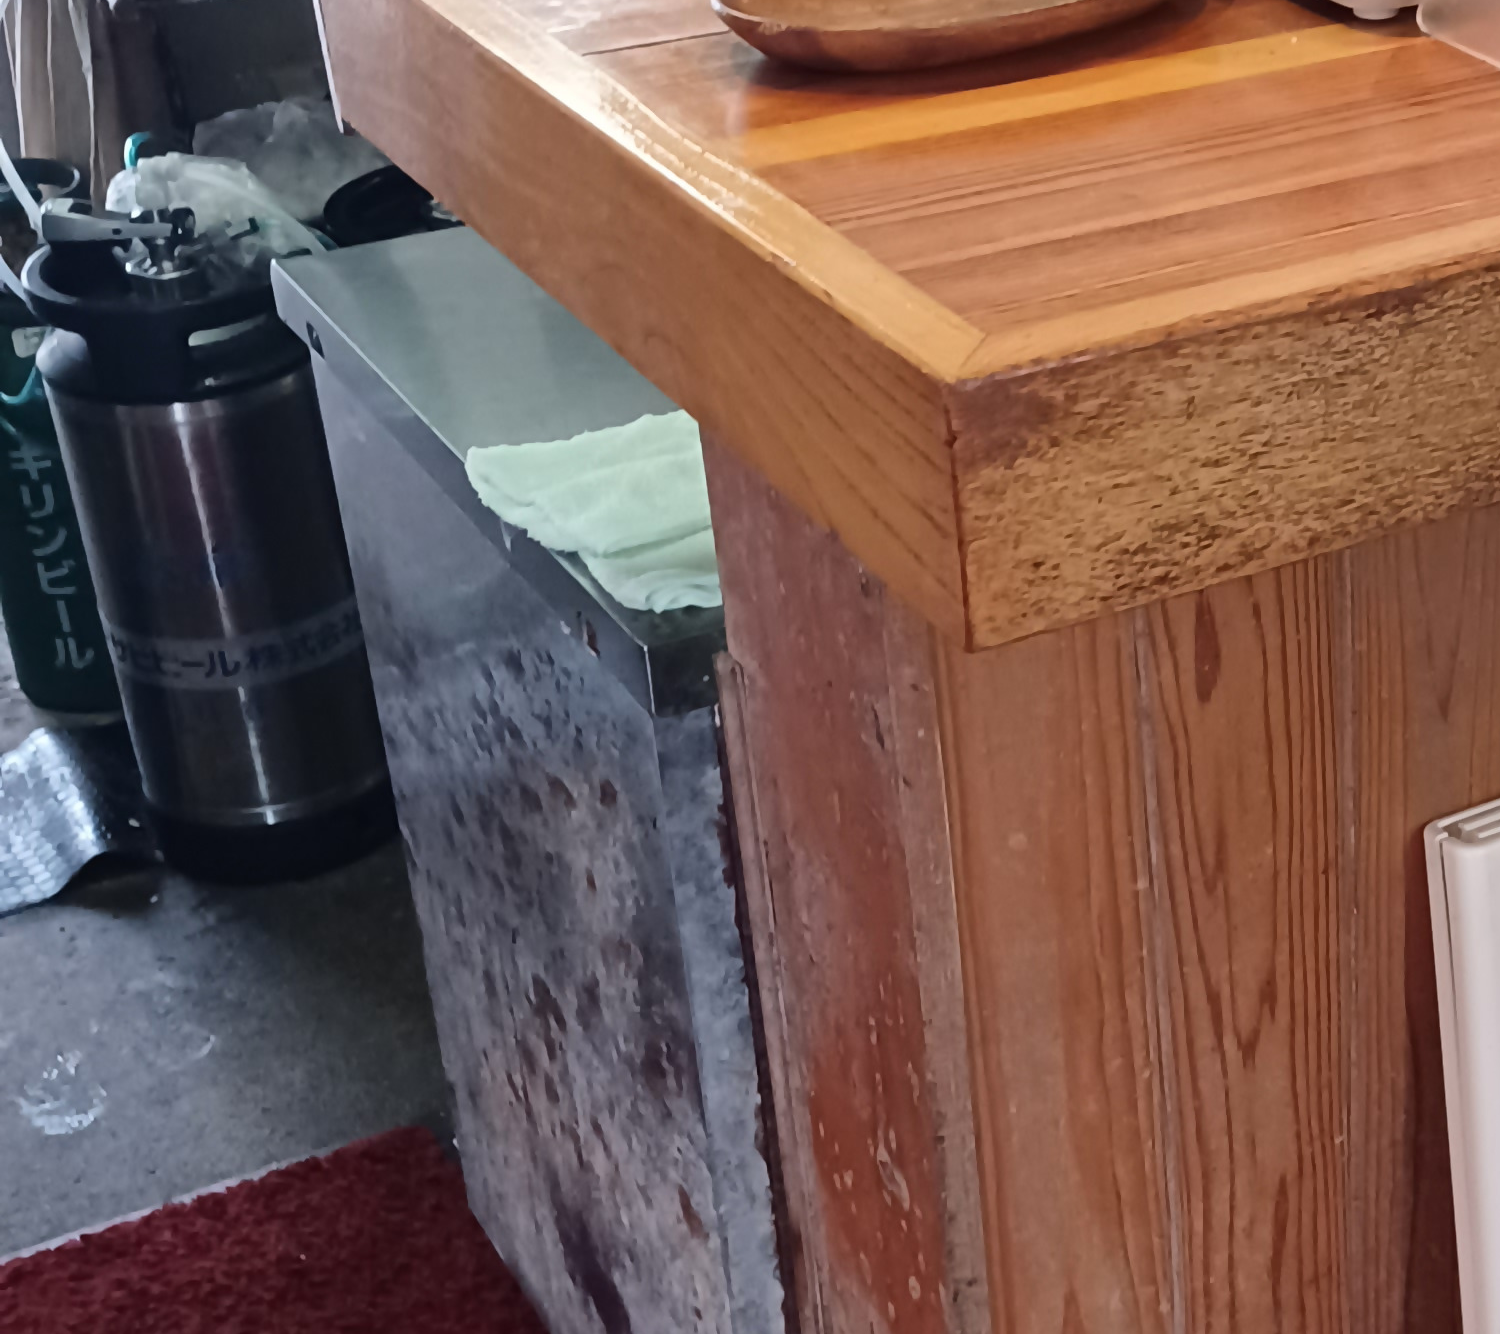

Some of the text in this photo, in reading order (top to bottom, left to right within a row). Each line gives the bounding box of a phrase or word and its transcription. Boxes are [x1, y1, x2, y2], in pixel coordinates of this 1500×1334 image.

[7, 444, 96, 670] キリンビール
